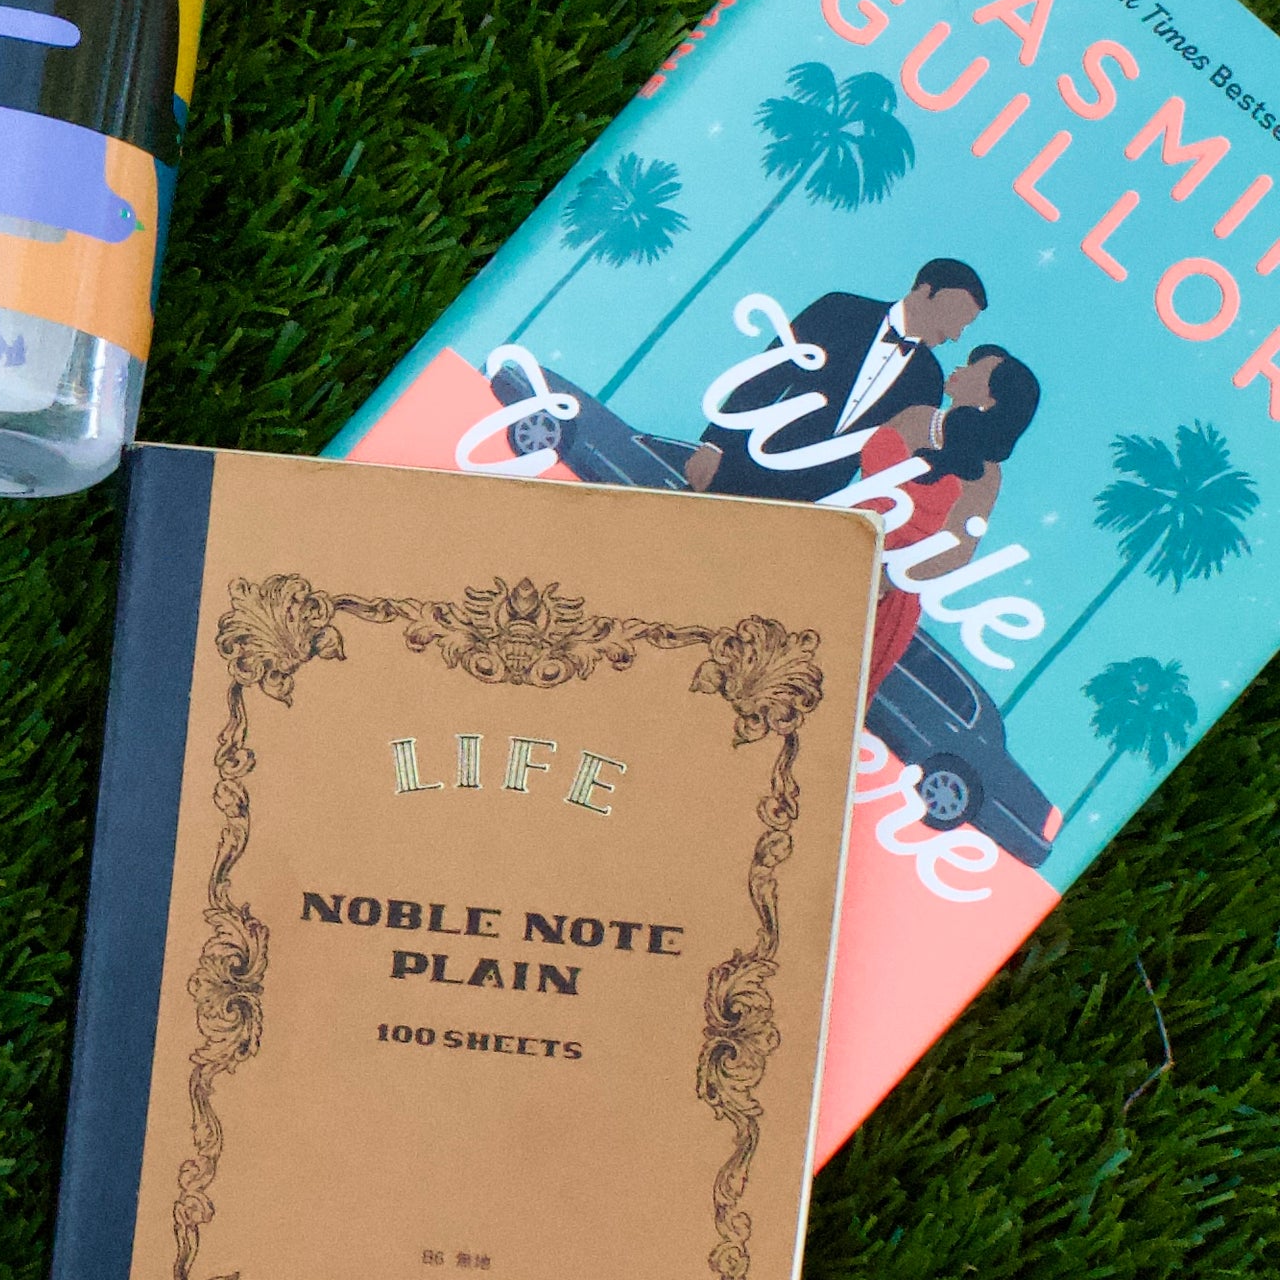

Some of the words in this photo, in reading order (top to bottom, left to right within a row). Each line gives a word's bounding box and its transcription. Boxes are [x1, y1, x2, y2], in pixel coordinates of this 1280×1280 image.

[1141, 2, 1210, 71] Times
[702, 293, 1045, 670] While
[389, 733, 628, 816] LIFE
[852, 731, 1000, 903] ere
[300, 891, 502, 939] NOBLE
[524, 912, 685, 957] NOTE
[390, 950, 581, 996] PLAIN
[377, 1024, 436, 1046] 100
[444, 1029, 583, 1060] SHEETS
